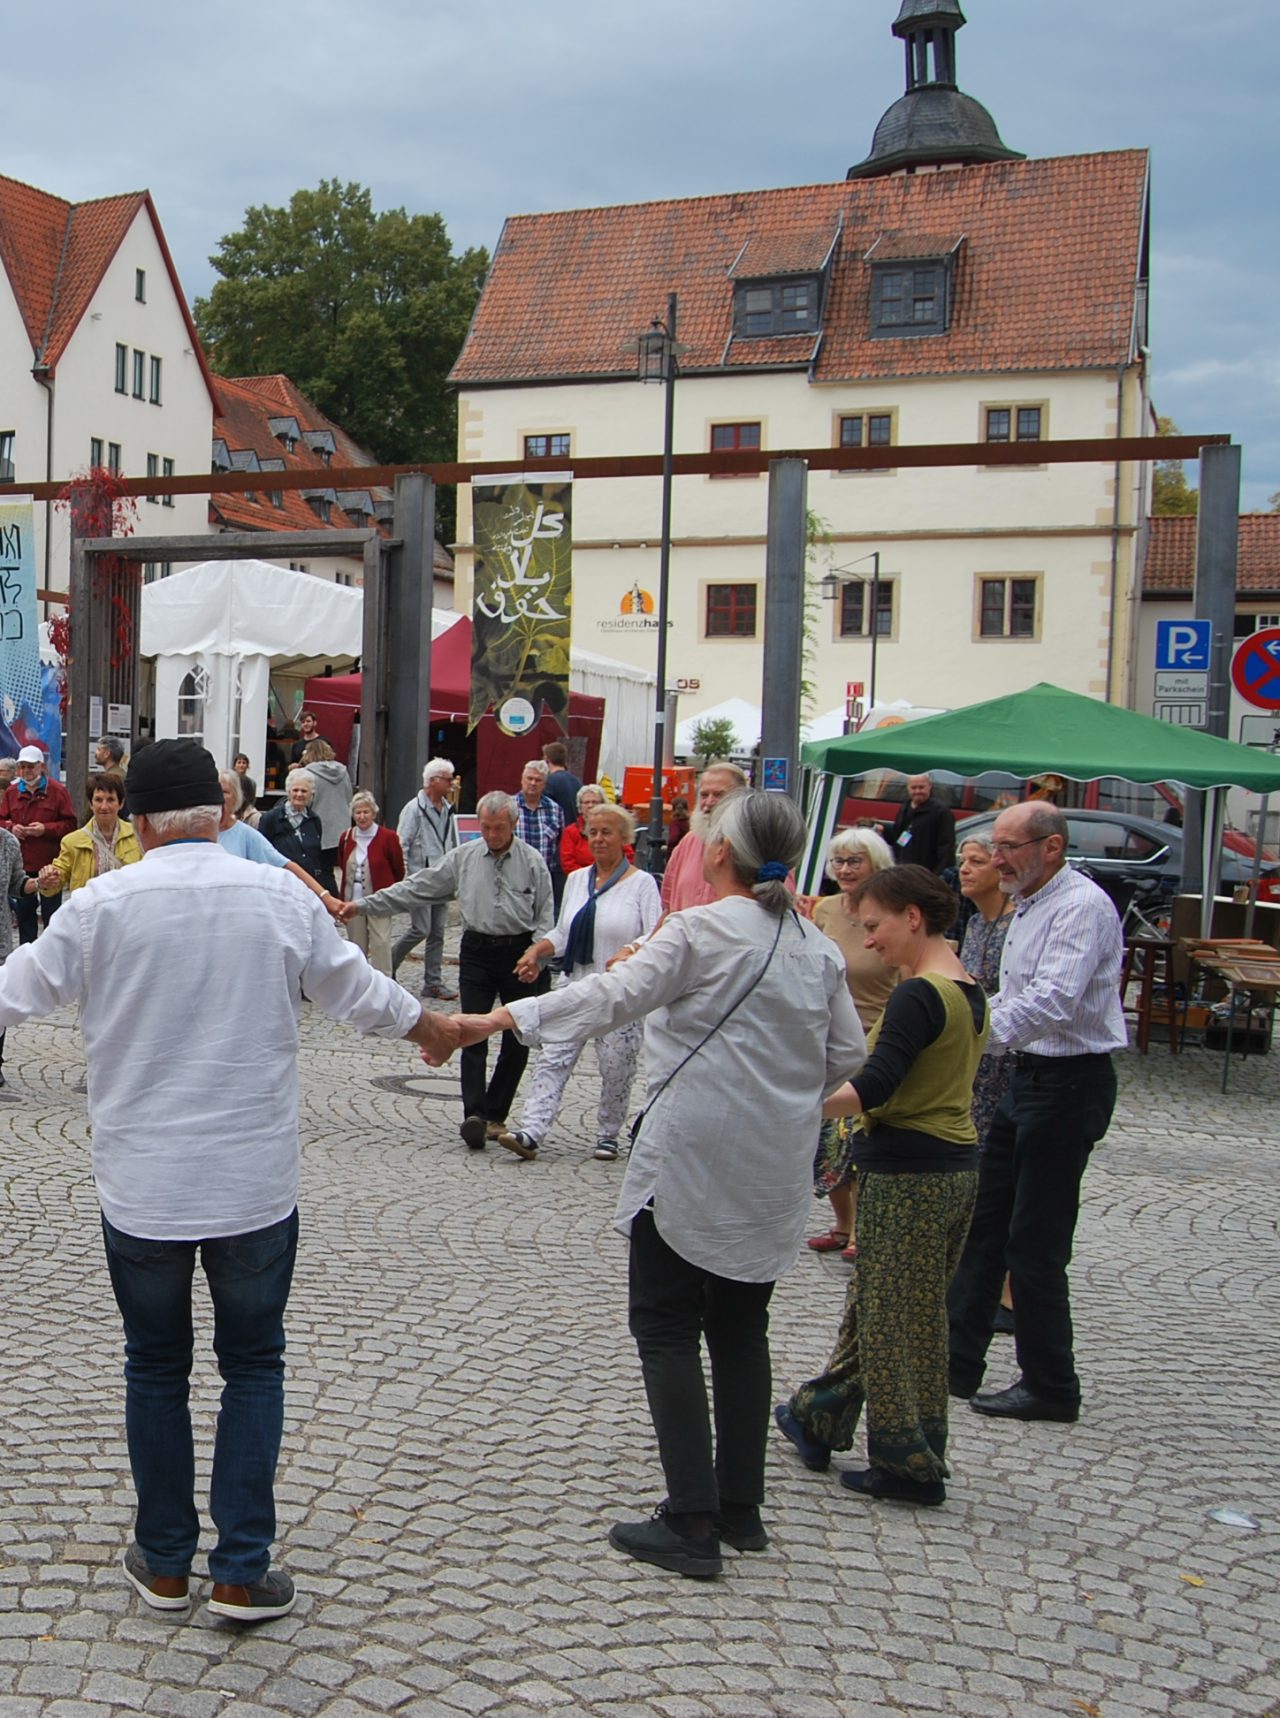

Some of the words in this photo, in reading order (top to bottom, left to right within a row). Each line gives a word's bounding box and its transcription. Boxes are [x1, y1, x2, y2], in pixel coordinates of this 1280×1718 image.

[596, 618, 674, 628] residenzhas
[1168, 626, 1198, 664] P
[1158, 685, 1205, 693] Parkschein
